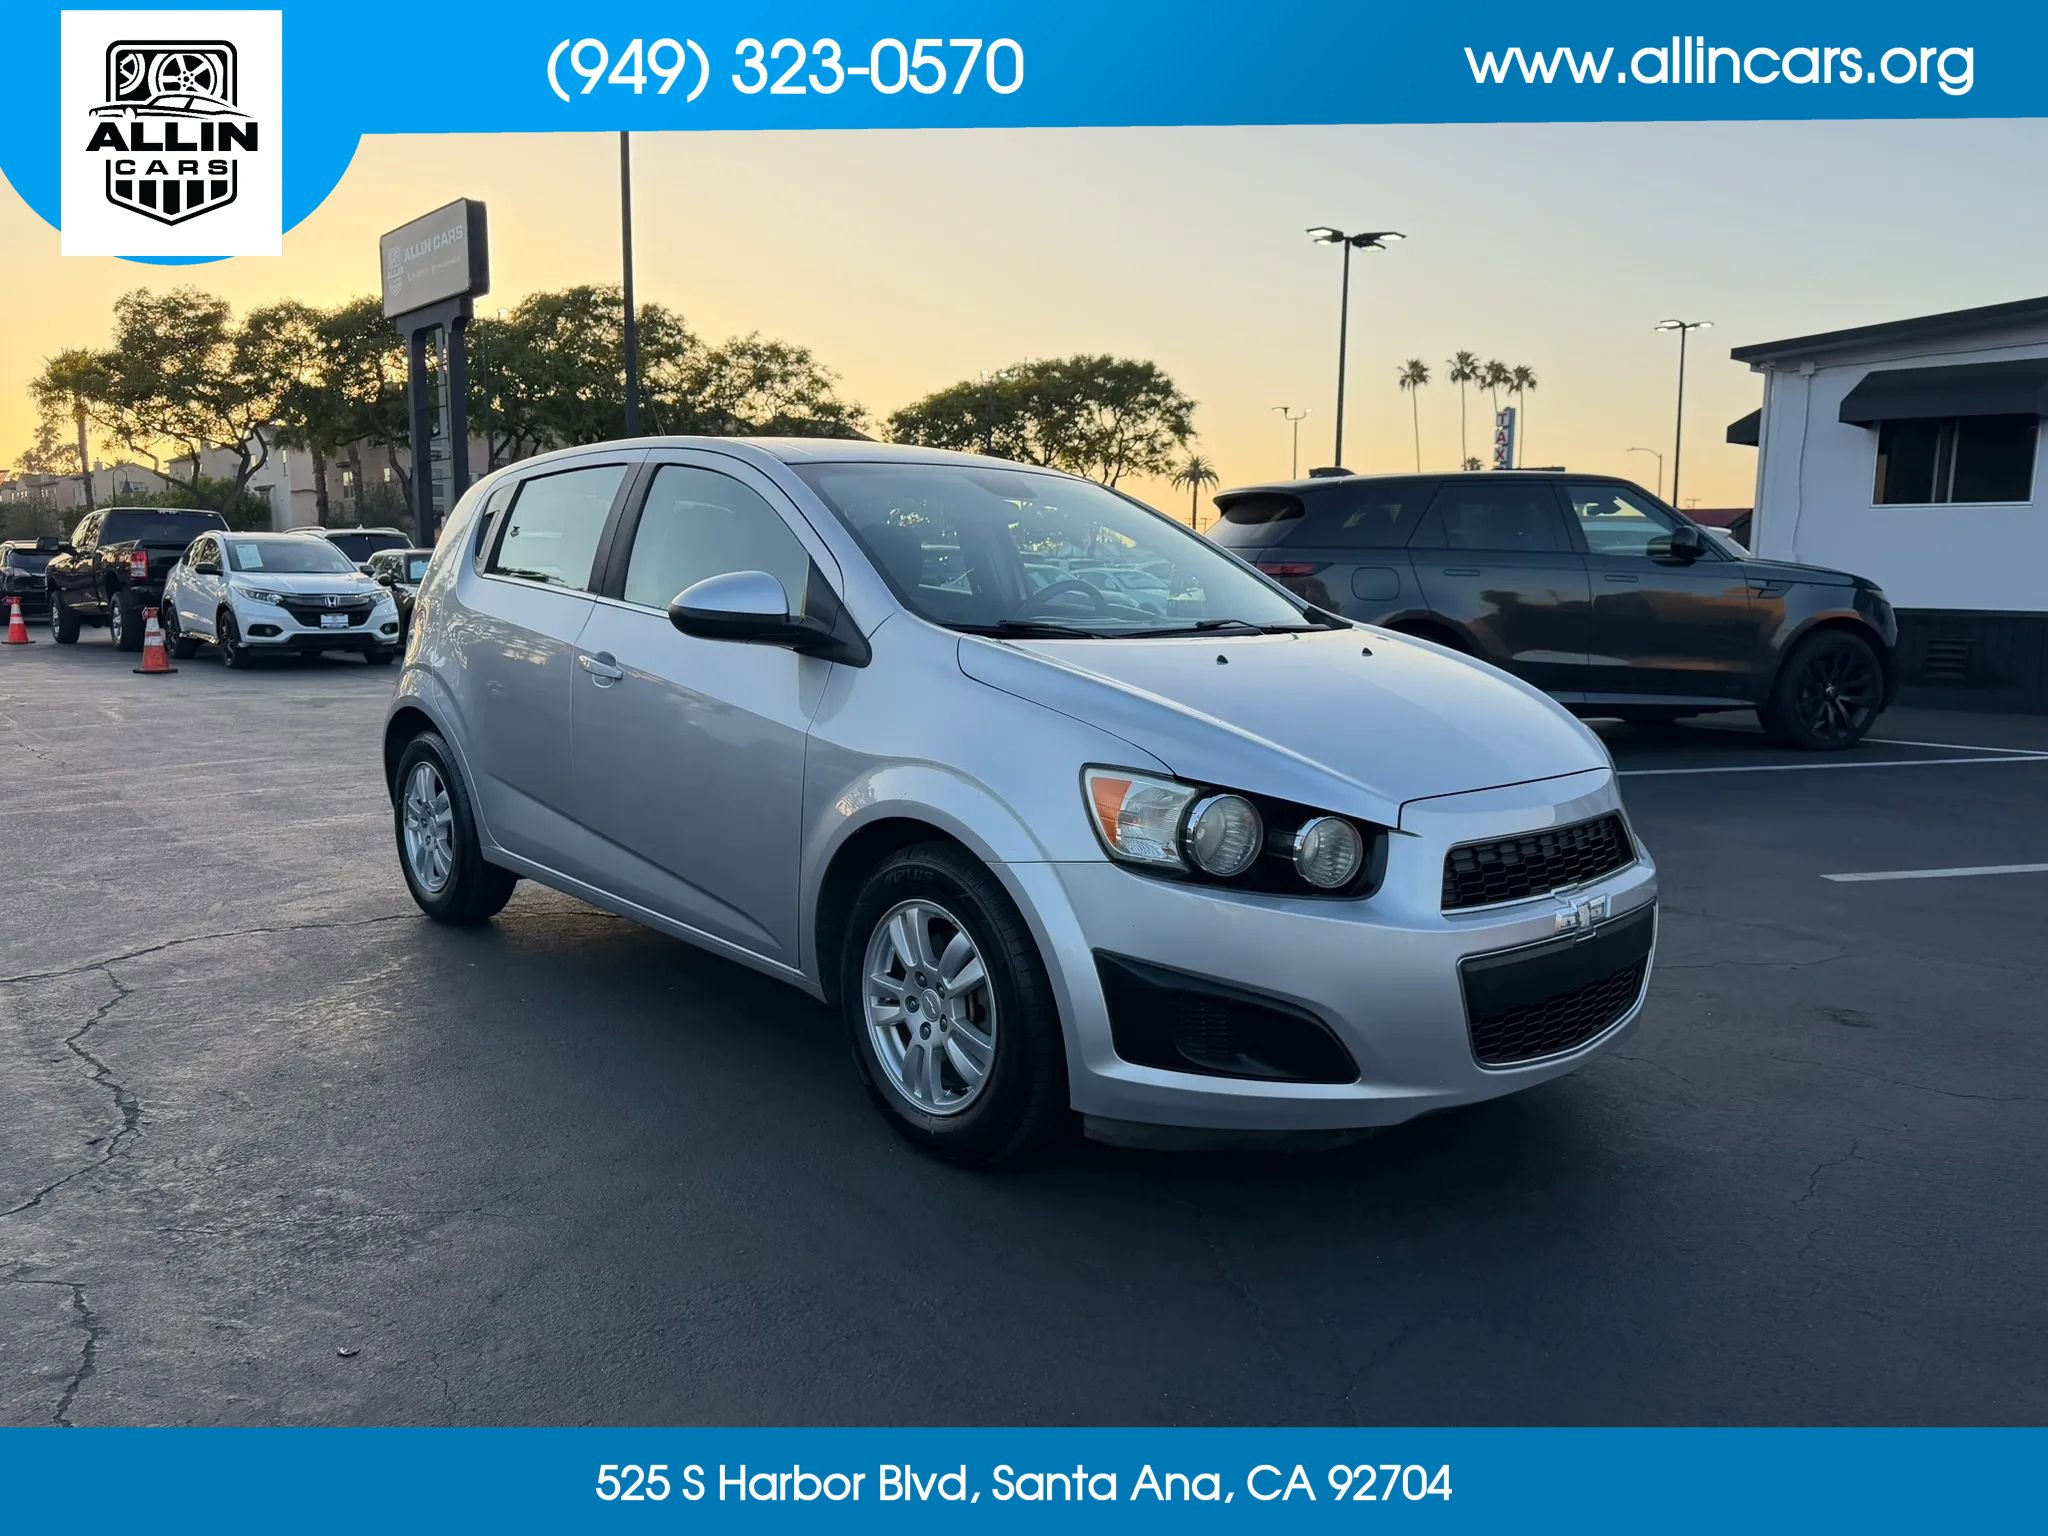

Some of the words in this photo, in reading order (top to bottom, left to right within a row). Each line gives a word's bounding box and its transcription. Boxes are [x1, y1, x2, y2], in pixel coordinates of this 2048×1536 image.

[404, 237, 432, 263] ALLIN
[433, 225, 464, 249] CARS
[1495, 412, 1508, 462] TAX
